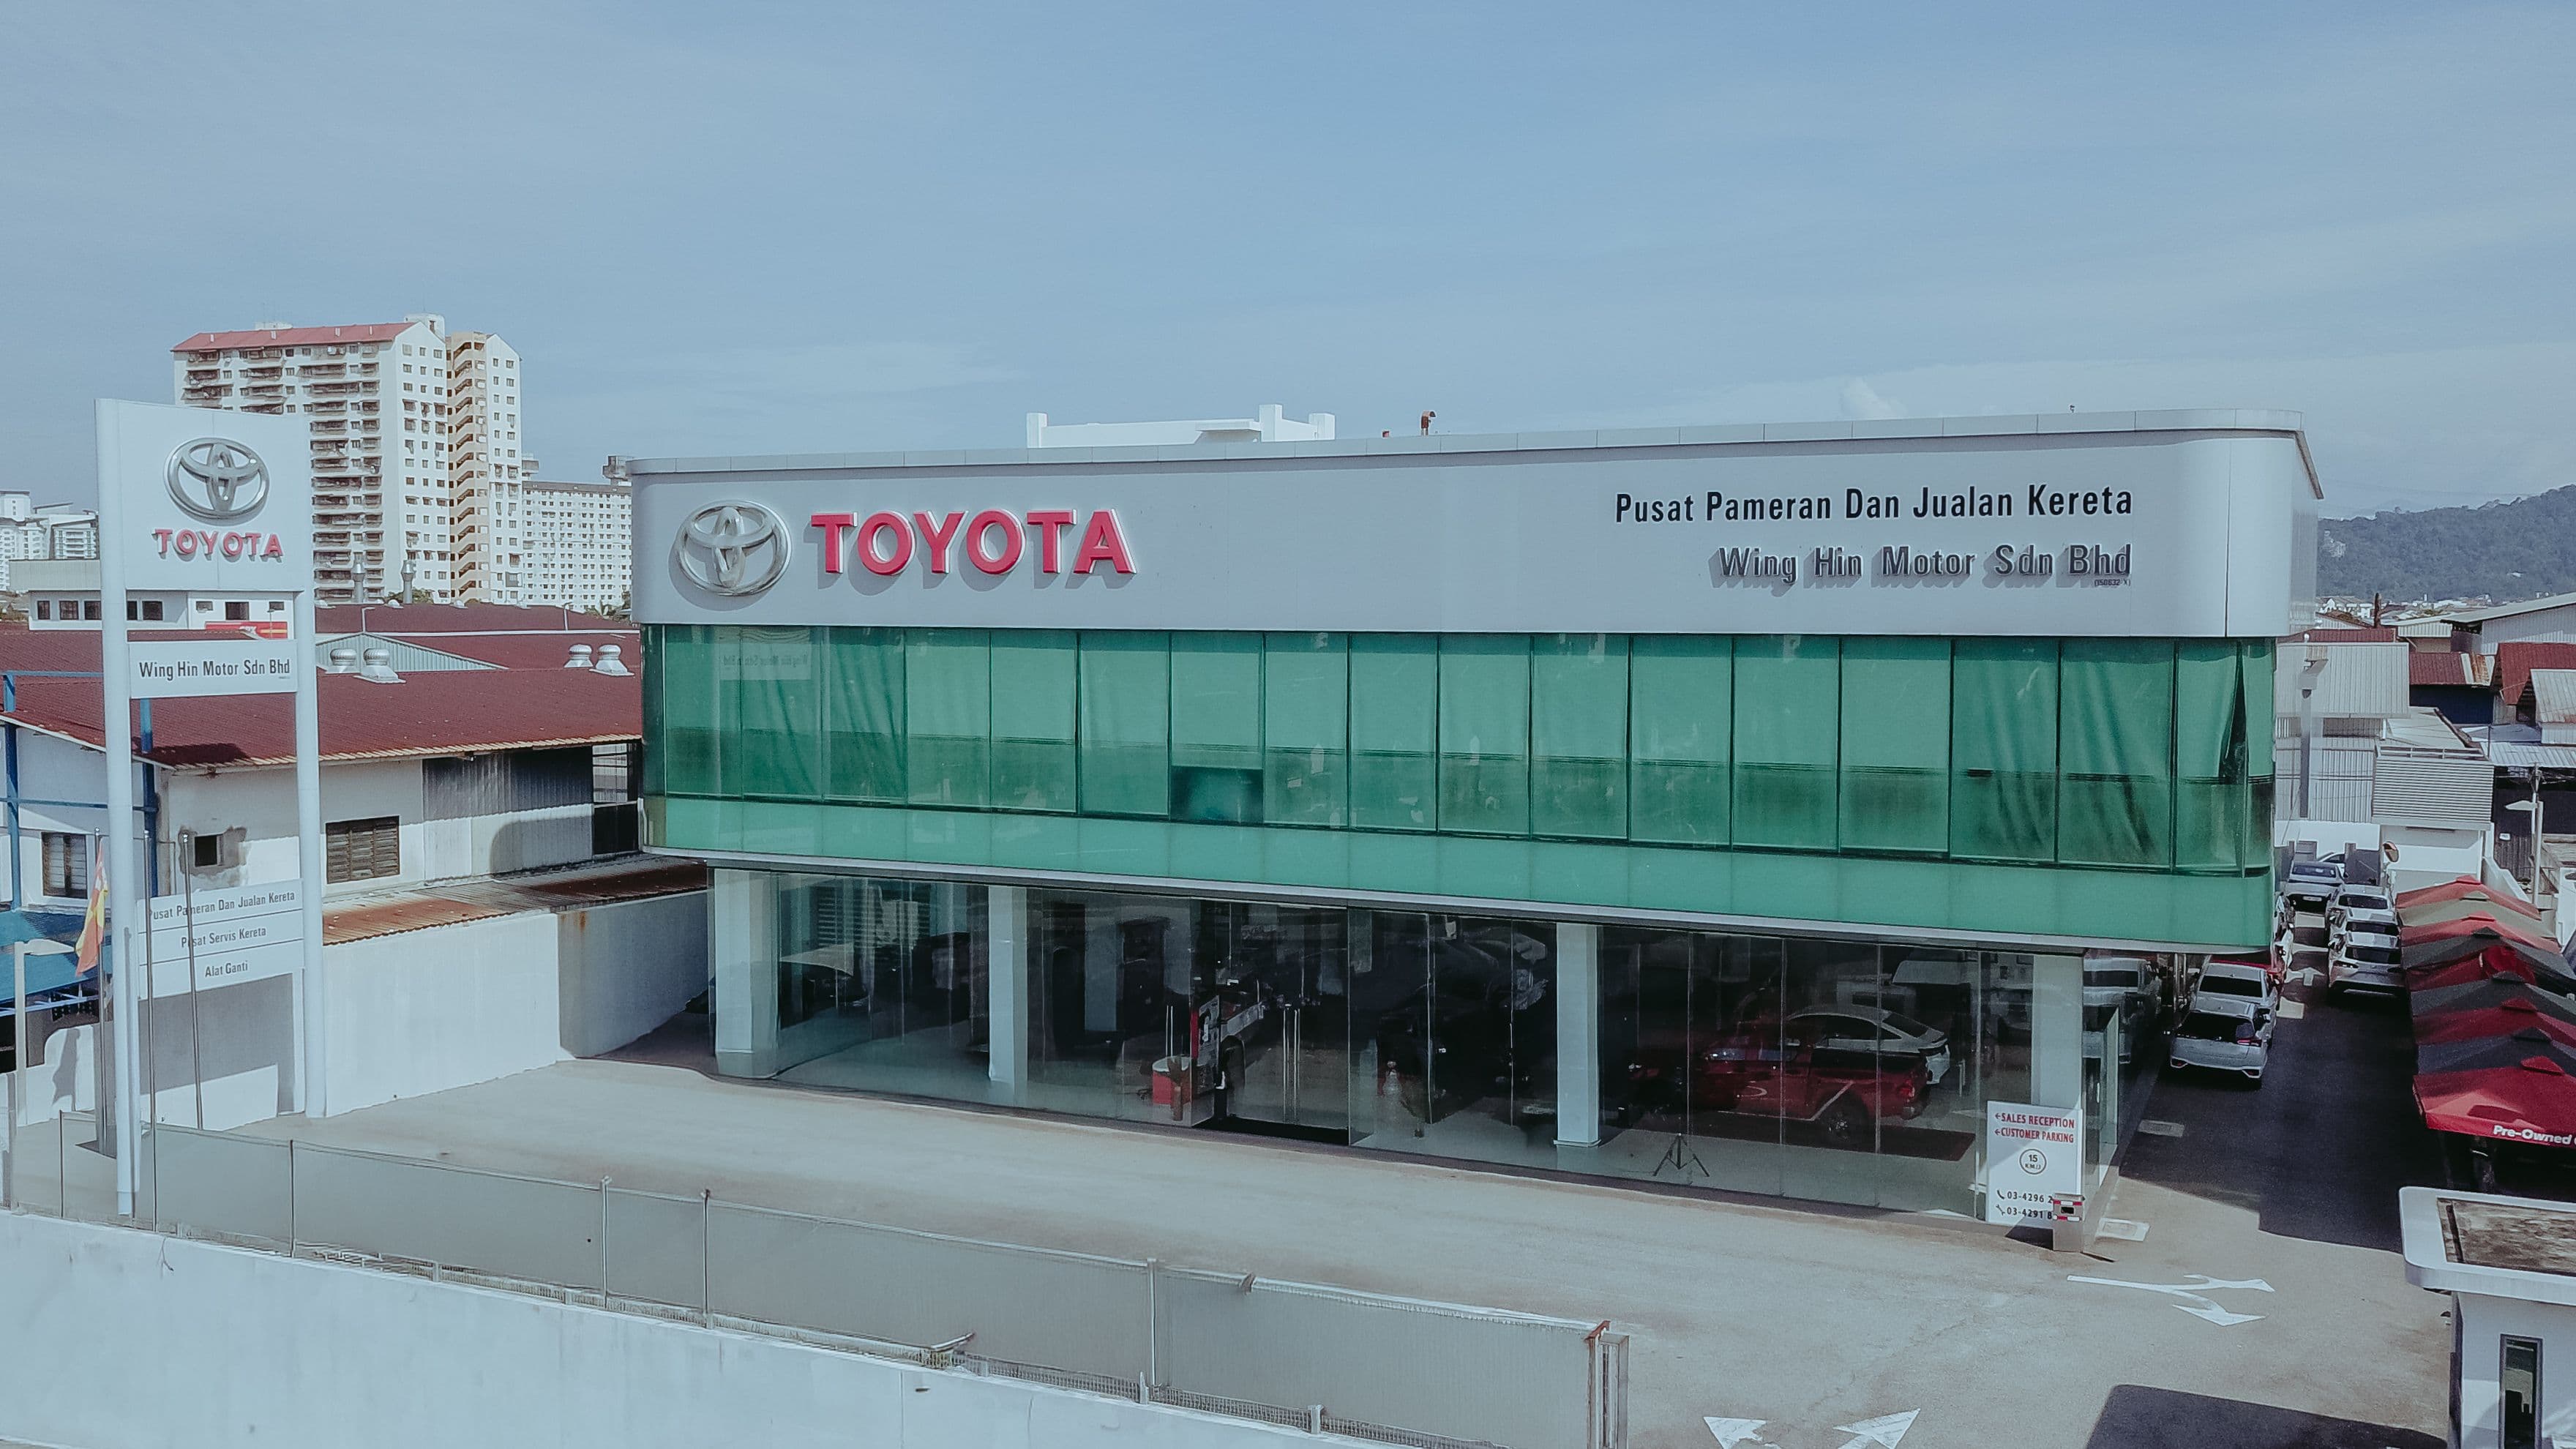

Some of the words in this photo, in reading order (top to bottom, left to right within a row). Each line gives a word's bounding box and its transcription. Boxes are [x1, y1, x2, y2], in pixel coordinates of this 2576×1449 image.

[1615, 493, 1694, 523] Pusat
[1706, 490, 1831, 521] Pameran
[1846, 487, 1899, 519] Dan
[1912, 485, 2012, 518] Jualan
[2028, 484, 2132, 516] Kereta
[152, 528, 284, 558] TOYOTA
[811, 509, 1137, 576] TOYOTA
[1718, 547, 1798, 585] Wing
[1813, 546, 1863, 577] Hin
[1881, 545, 1976, 576] Motor
[1993, 544, 2053, 575] Sdn
[2067, 543, 2132, 575] Bhd
[138, 662, 174, 681] Wing
[177, 661, 198, 677] Hin
[203, 660, 239, 676] Motor
[244, 659, 266, 675] Sdn
[269, 659, 291, 674] Bhd
[219, 899, 235, 910] Dan
[238, 894, 266, 908] Jualan
[269, 891, 295, 903] Kereta
[181, 935, 206, 948] Psat
[209, 932, 236, 944] Servis
[239, 927, 266, 939] Kereta
[205, 965, 223, 978] Alat
[225, 960, 249, 975] Ganti
[2001, 1112, 2026, 1124] SALES
[2029, 1115, 2075, 1128] RECEPTION
[2001, 1127, 2040, 1139] CUSTOMER
[2042, 1131, 2074, 1143] PARKING
[2493, 1125, 2572, 1145] Pre-Owned
[2028, 1154, 2038, 1162] 15
[2007, 1191, 2045, 1202] 03-4296
[2007, 1207, 2043, 1218] 03-4291
